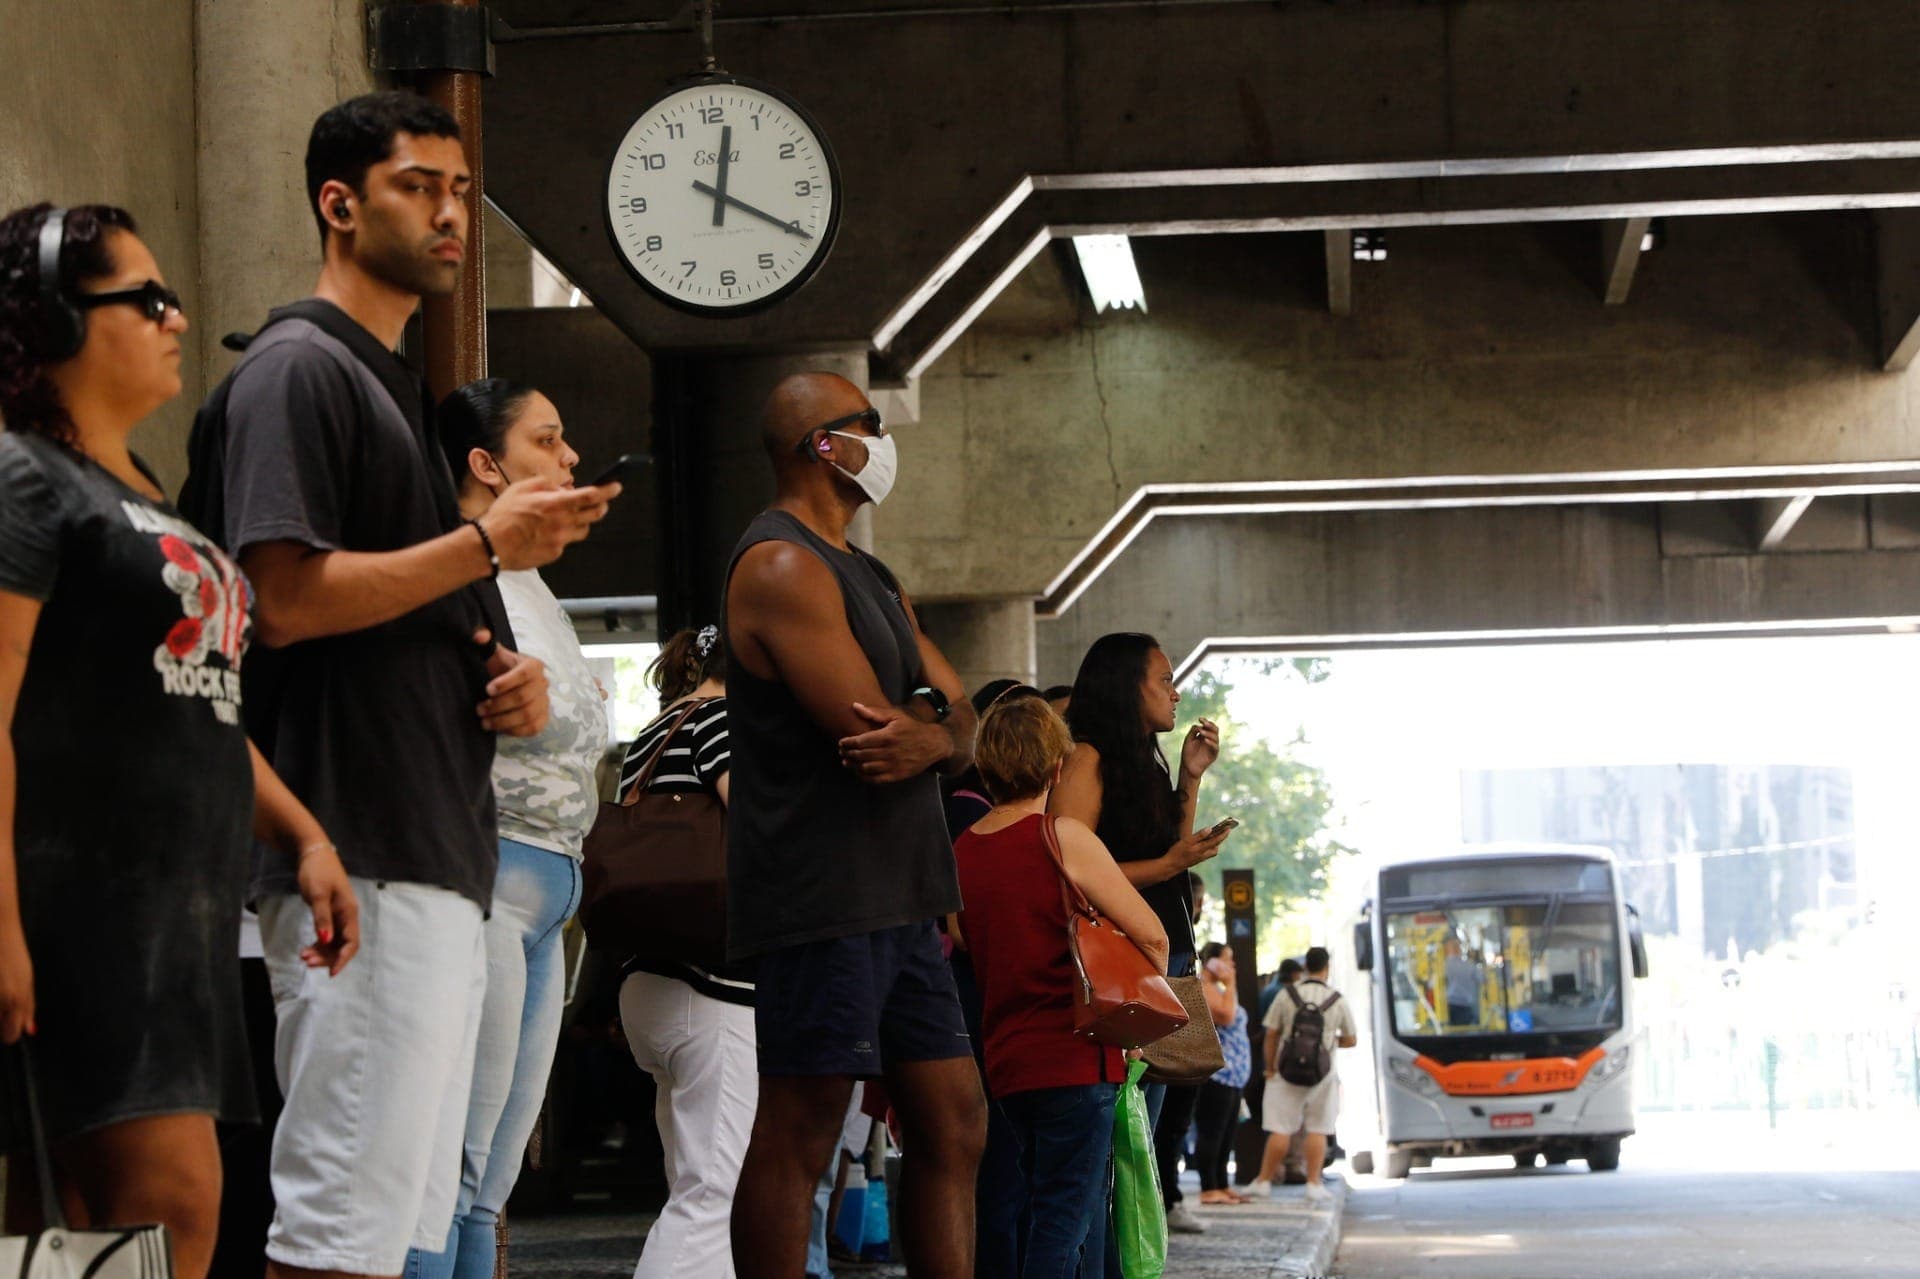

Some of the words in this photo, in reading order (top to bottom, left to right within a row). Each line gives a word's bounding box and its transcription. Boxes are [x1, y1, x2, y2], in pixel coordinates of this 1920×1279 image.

[698, 107, 725, 125] 12
[750, 115, 760, 131] 1
[665, 123, 684, 140] 11
[694, 149, 740, 166] Esa
[778, 142, 797, 160] 2
[640, 153, 666, 171] 10
[794, 181, 811, 197] 3
[630, 197, 647, 214] 9
[646, 235, 663, 252] 8
[680, 260, 697, 278] 7
[757, 253, 775, 270] 5
[719, 270, 737, 286] 6
[162, 663, 225, 699] ROCK
